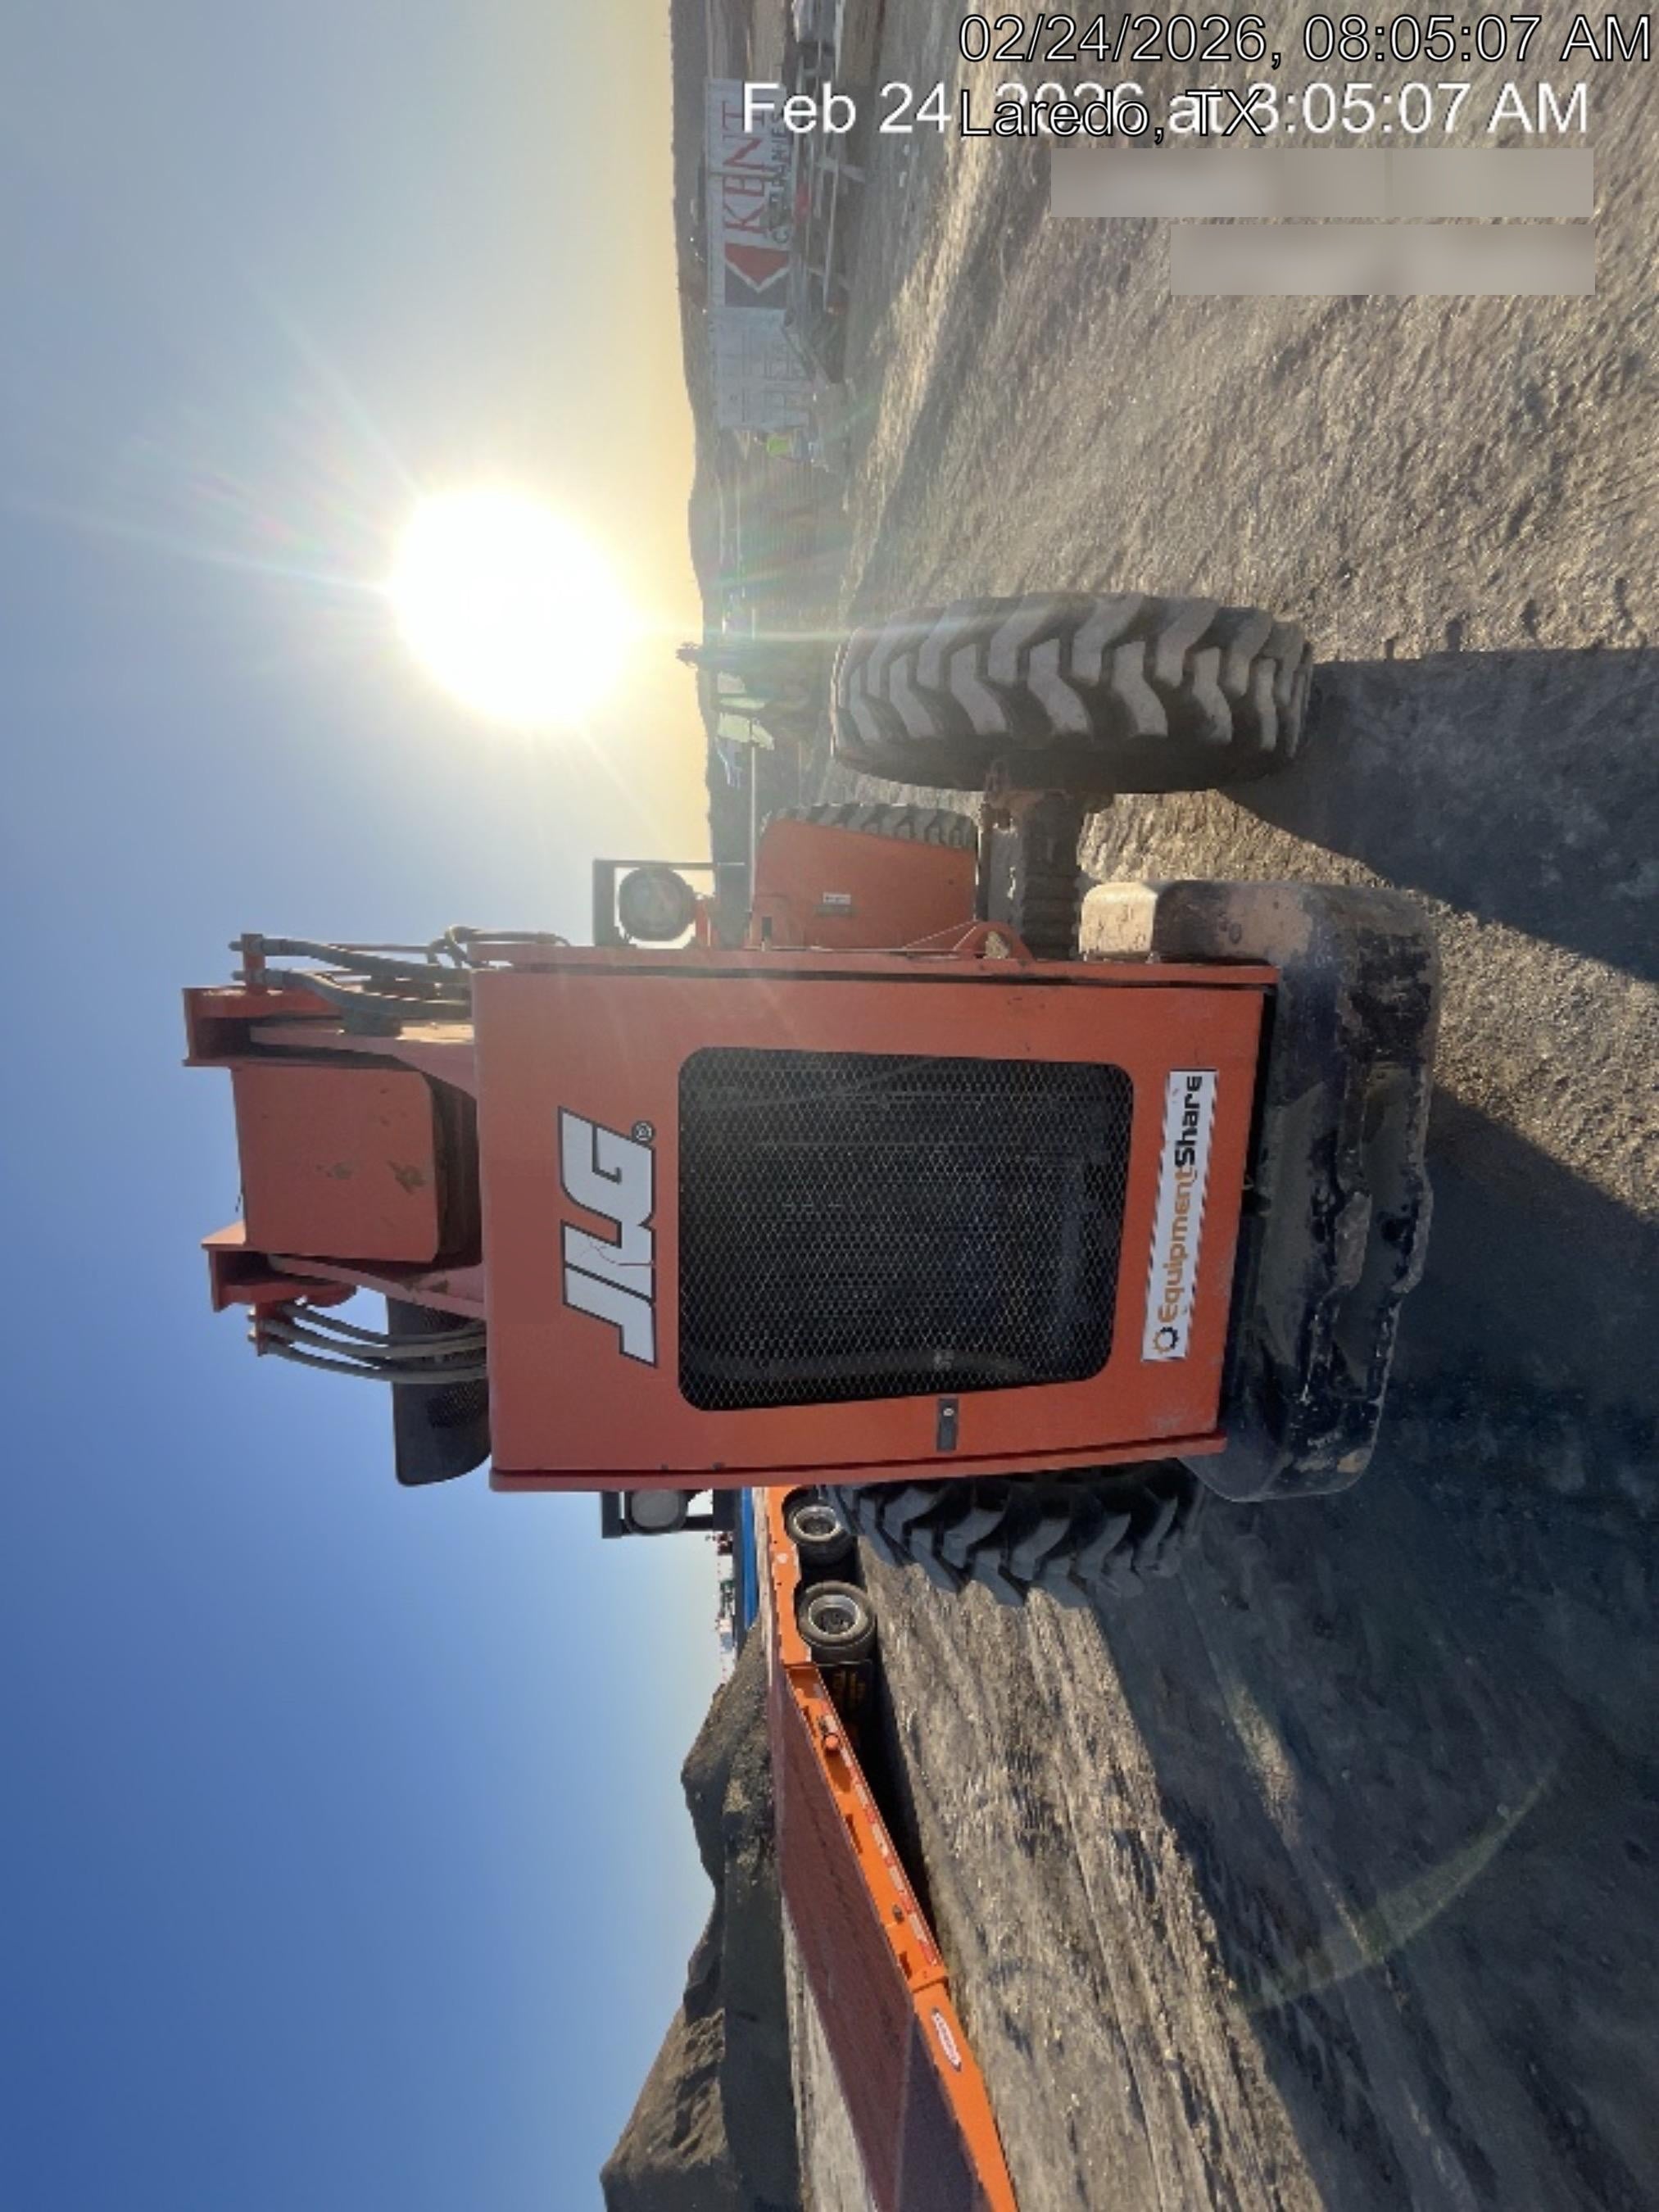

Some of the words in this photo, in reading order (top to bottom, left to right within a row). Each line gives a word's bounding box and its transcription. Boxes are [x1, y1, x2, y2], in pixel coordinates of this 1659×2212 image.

[721, 99, 767, 237] KENT
[557, 1105, 657, 1367] JLG
[1156, 1075, 1203, 1323] EquipmentShare
